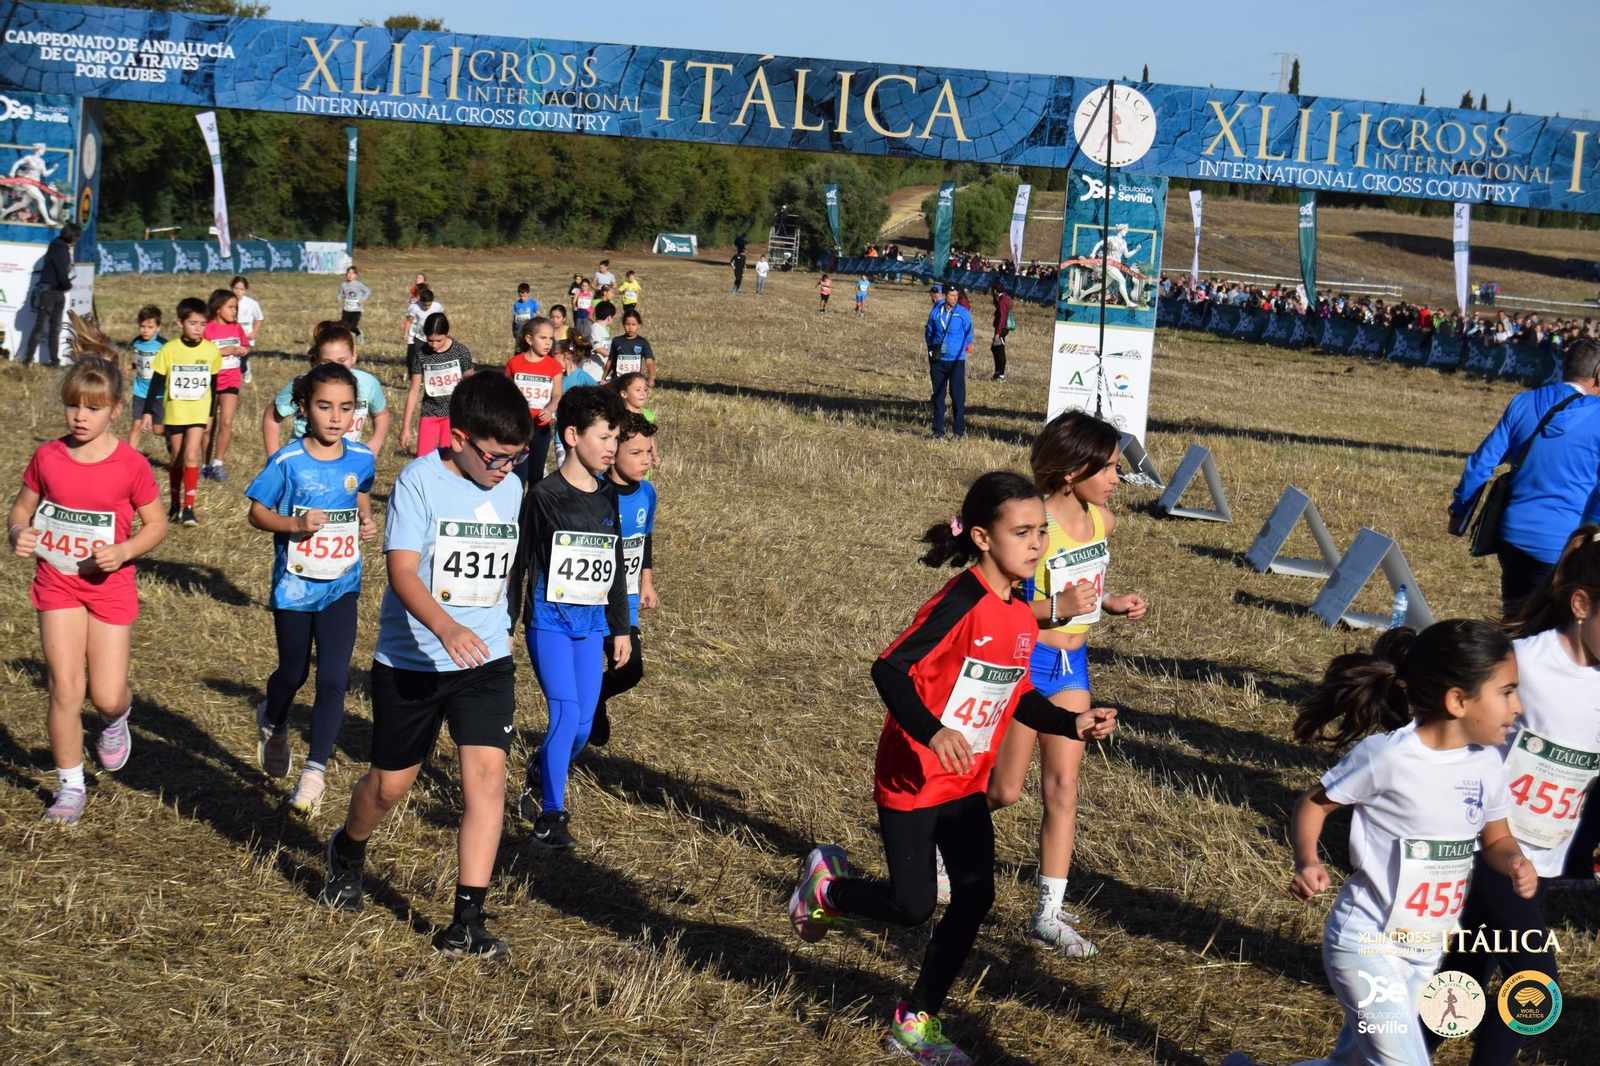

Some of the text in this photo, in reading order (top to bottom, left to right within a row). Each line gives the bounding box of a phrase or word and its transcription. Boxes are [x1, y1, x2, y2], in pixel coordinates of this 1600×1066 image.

[5, 30, 235, 59] CAMPEONATO DE ANDALUCÍA
[40, 46, 62, 60] DE
[63, 50, 122, 65] CAMPO
[124, 53, 137, 67] A
[75, 63, 166, 83] POR CLUBES
[297, 36, 599, 101] XLIII CROSS
[467, 85, 643, 114] INTERNACIONAL
[656, 54, 972, 143] ITÁLICA
[34, 112, 69, 123] Sevilla
[295, 95, 611, 132] INTERNATIONAL CROSS COUNTRY
[1202, 100, 1374, 169] XLIII
[1377, 116, 1509, 159] CROSS
[1375, 152, 1554, 185] INTERNACIONAL
[1118, 184, 1154, 194] Diputación
[1198, 159, 1521, 203] INTERNATIONAL CROSS COUNTRY
[1117, 192, 1153, 204] Sevilla
[619, 363, 639, 372] 4533
[174, 377, 208, 389] 4294
[428, 373, 459, 387] 4384
[519, 386, 549, 400] 4534
[347, 417, 364, 433] 20
[56, 509, 93, 524] ITÁLICA
[329, 512, 347, 522] LICA
[464, 524, 502, 536] ITÁLICA
[296, 534, 355, 559] 4528
[1070, 548, 1100, 562] ITÁLICA
[443, 551, 509, 579] 4311
[558, 557, 612, 582] 4289
[624, 556, 640, 575] 59
[1548, 747, 1591, 766] ITÁLICA
[1438, 842, 1473, 857] ITÁLIC
[1404, 879, 1466, 918] 455
